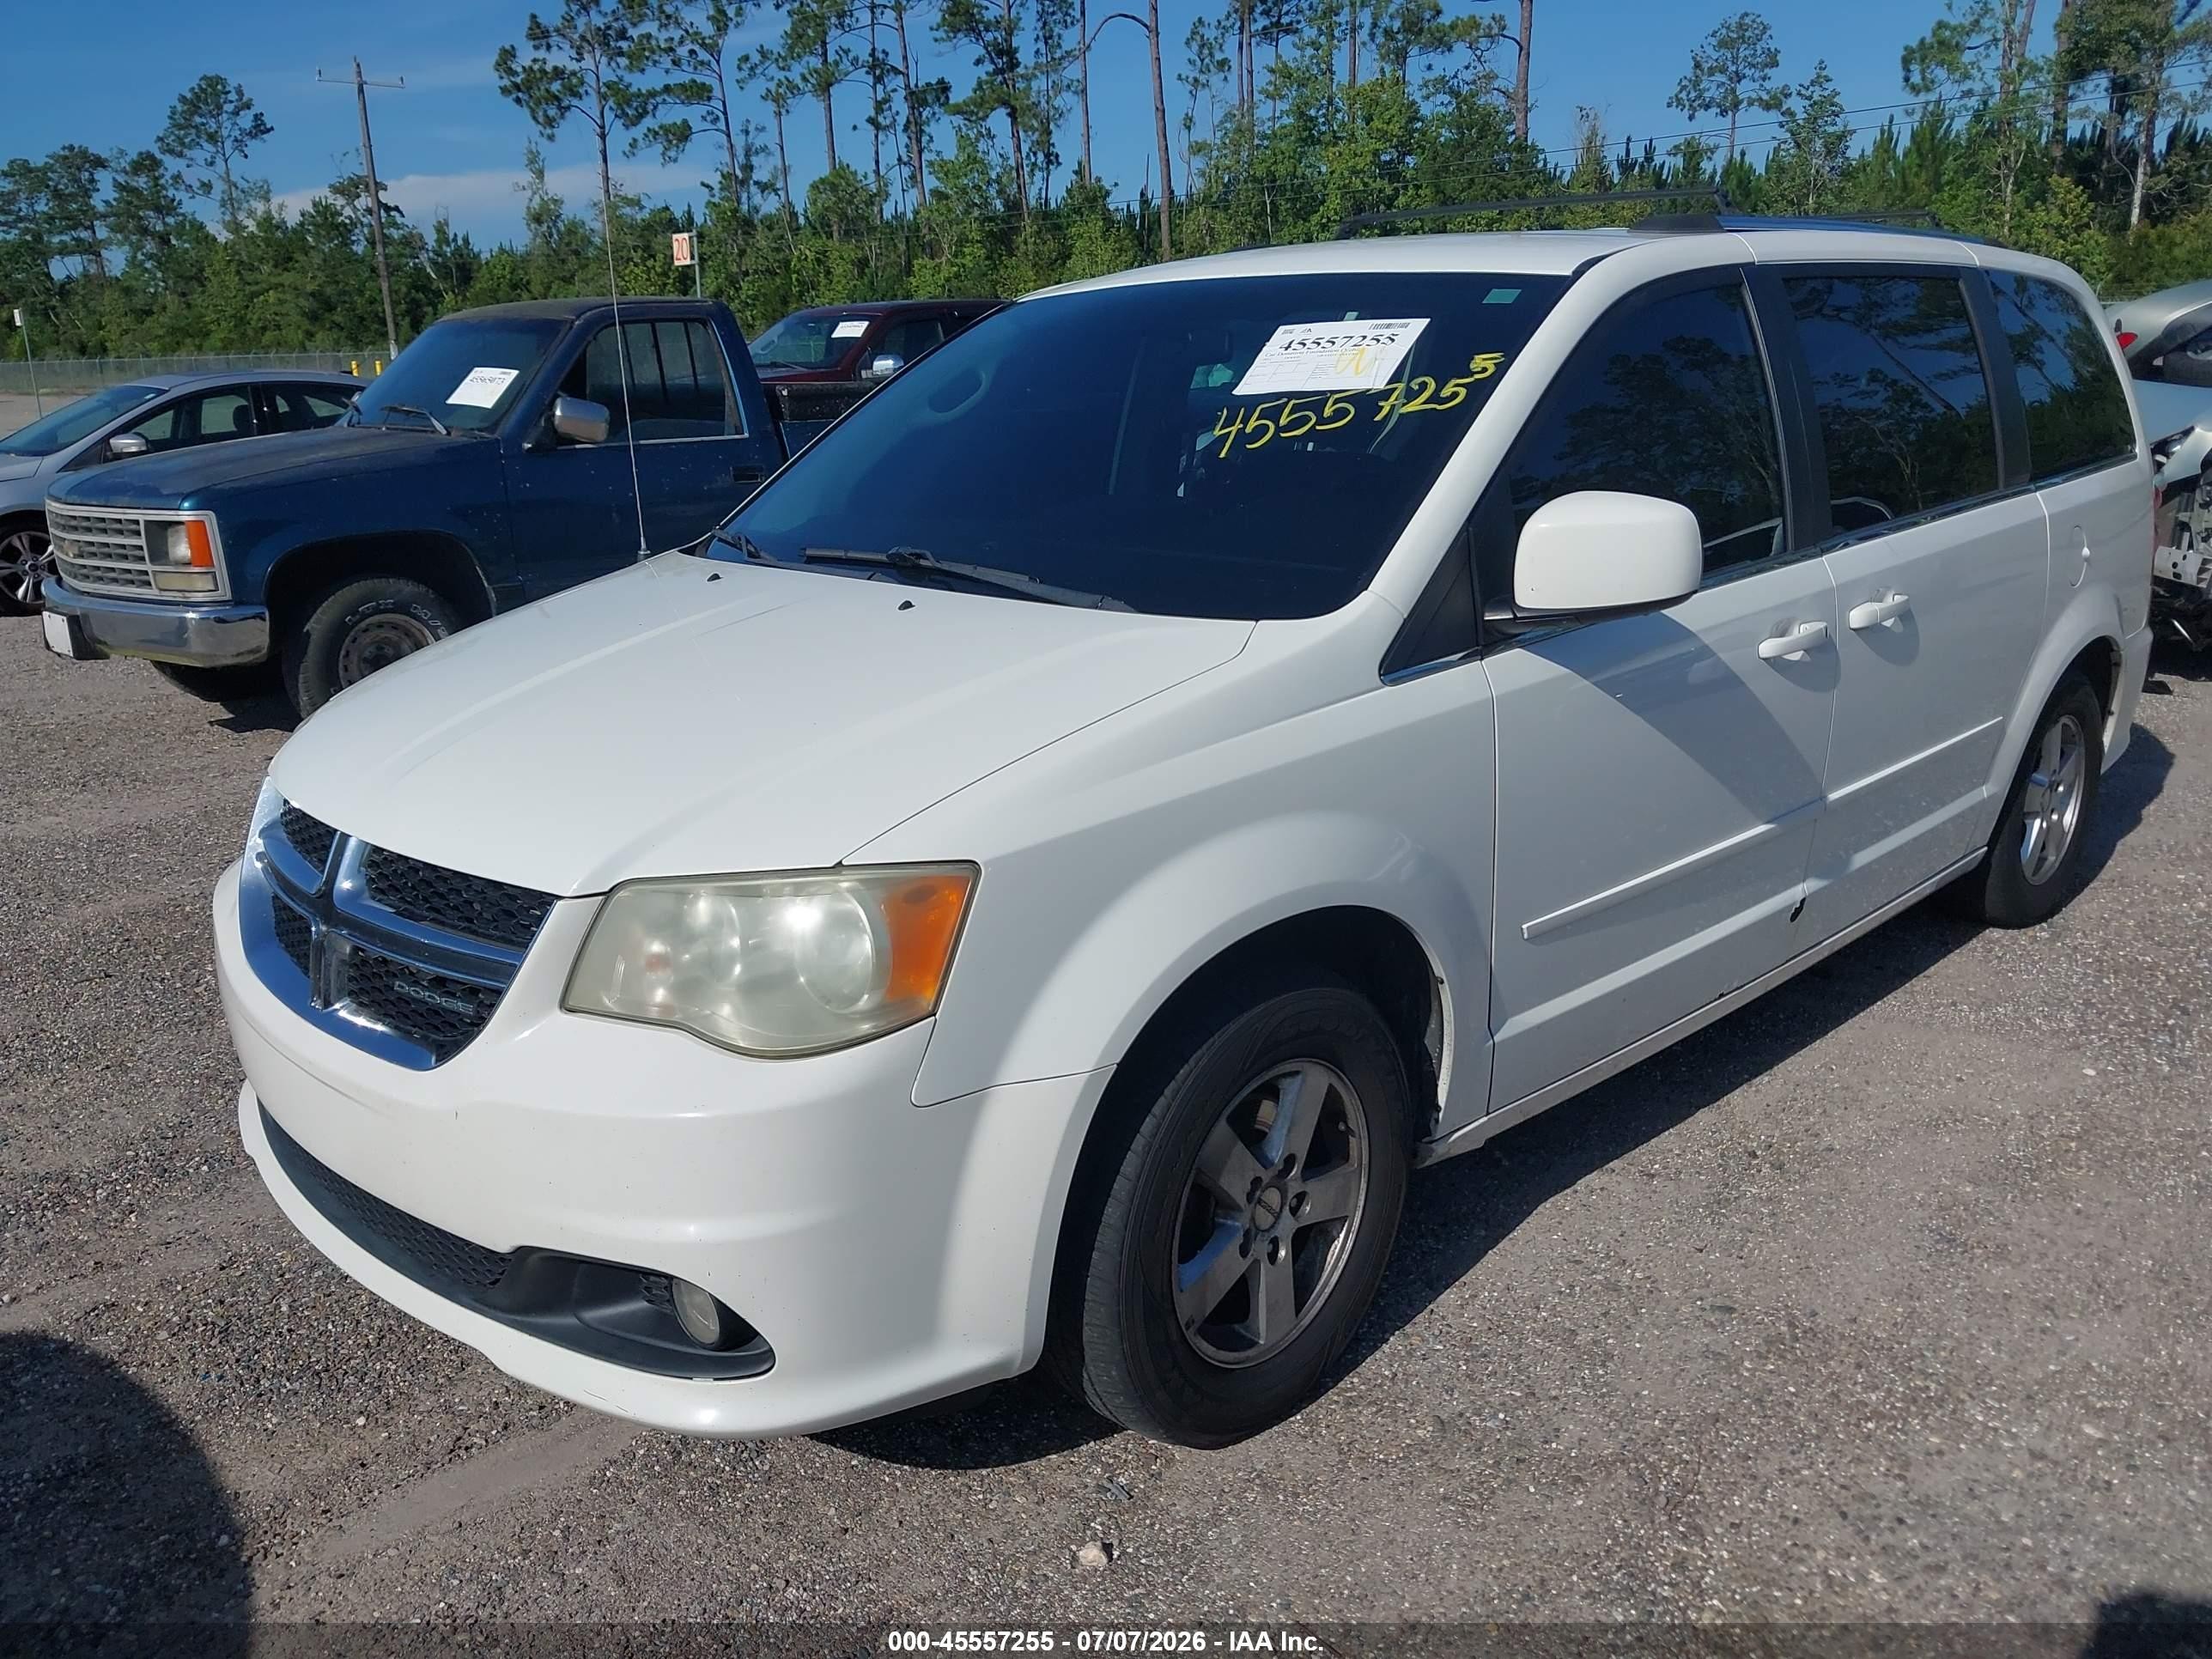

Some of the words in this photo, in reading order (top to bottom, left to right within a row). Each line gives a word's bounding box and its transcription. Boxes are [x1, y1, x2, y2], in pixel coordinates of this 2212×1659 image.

[674, 237, 689, 261] 20
[1279, 332, 1401, 351] 45557255
[344, 599, 395, 626] LTX
[393, 981, 474, 1015] DODGE
